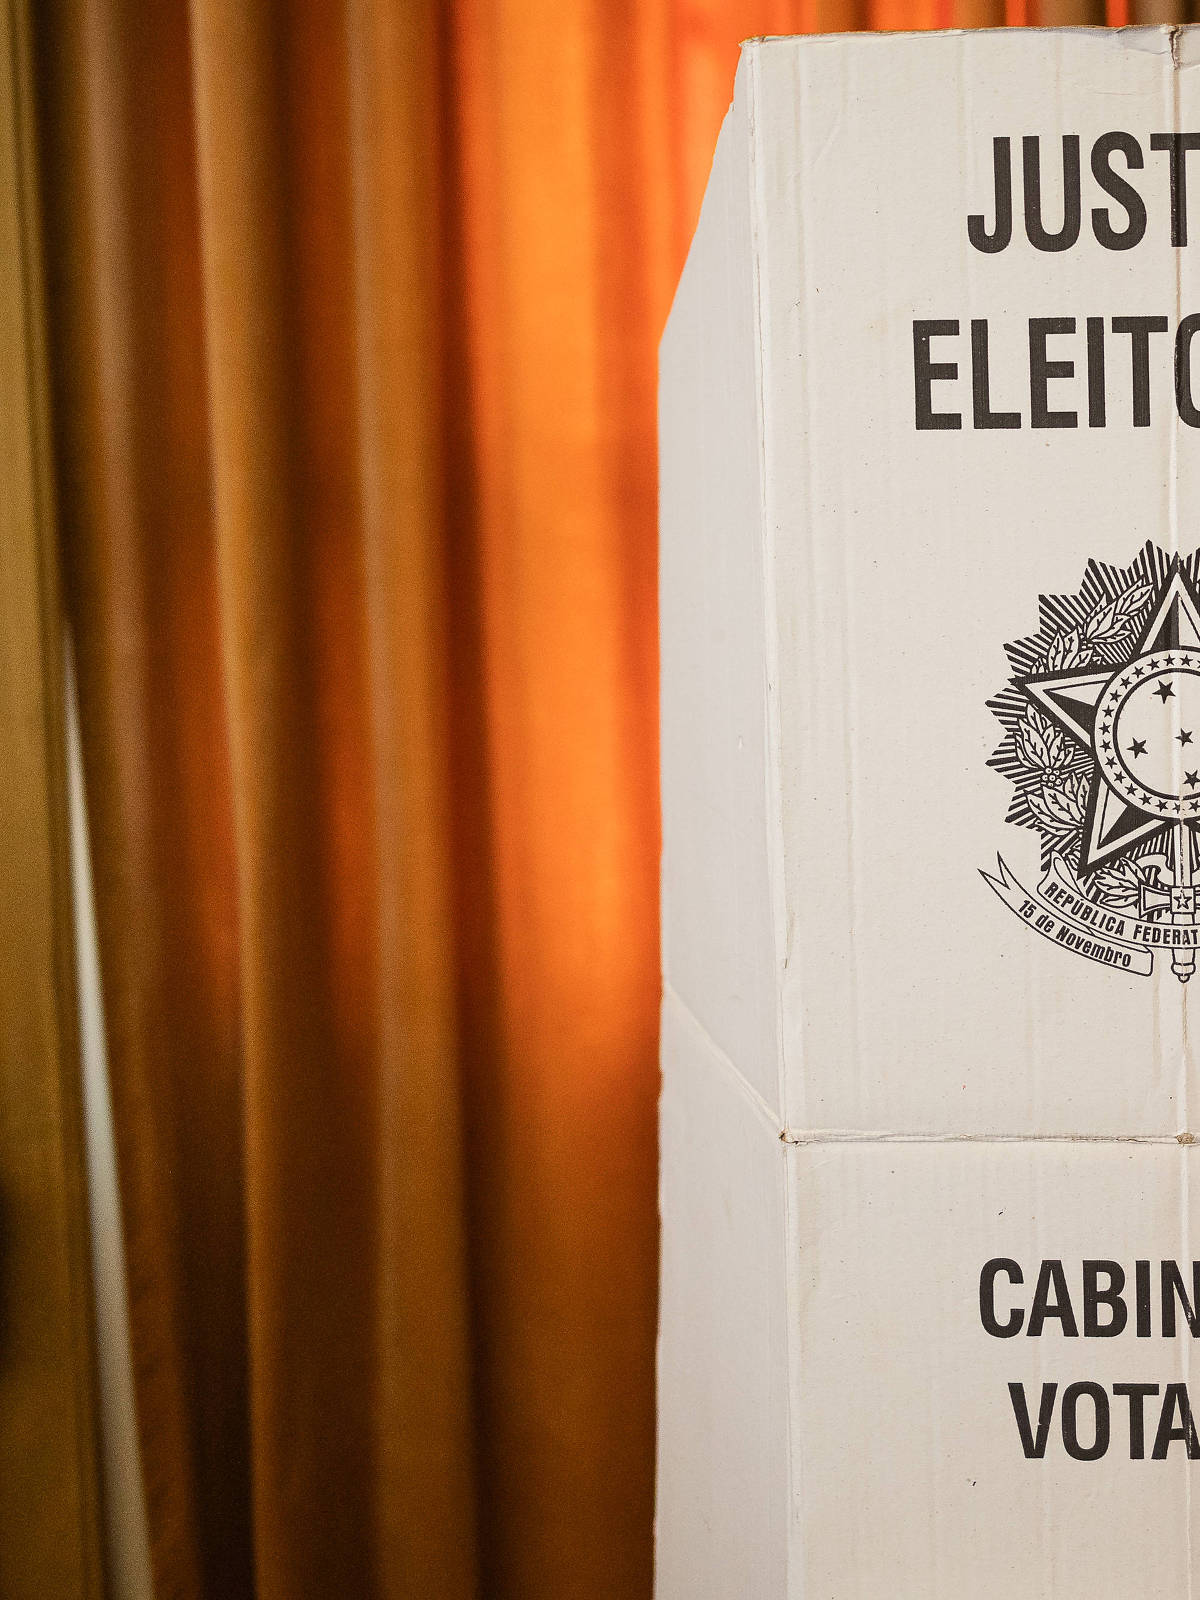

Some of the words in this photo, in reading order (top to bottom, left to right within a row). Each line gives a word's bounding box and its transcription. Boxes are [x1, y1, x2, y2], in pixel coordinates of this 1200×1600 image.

[1018, 899, 1037, 919] 15
[1034, 914, 1055, 933] de
[1055, 924, 1132, 968] Novembro
